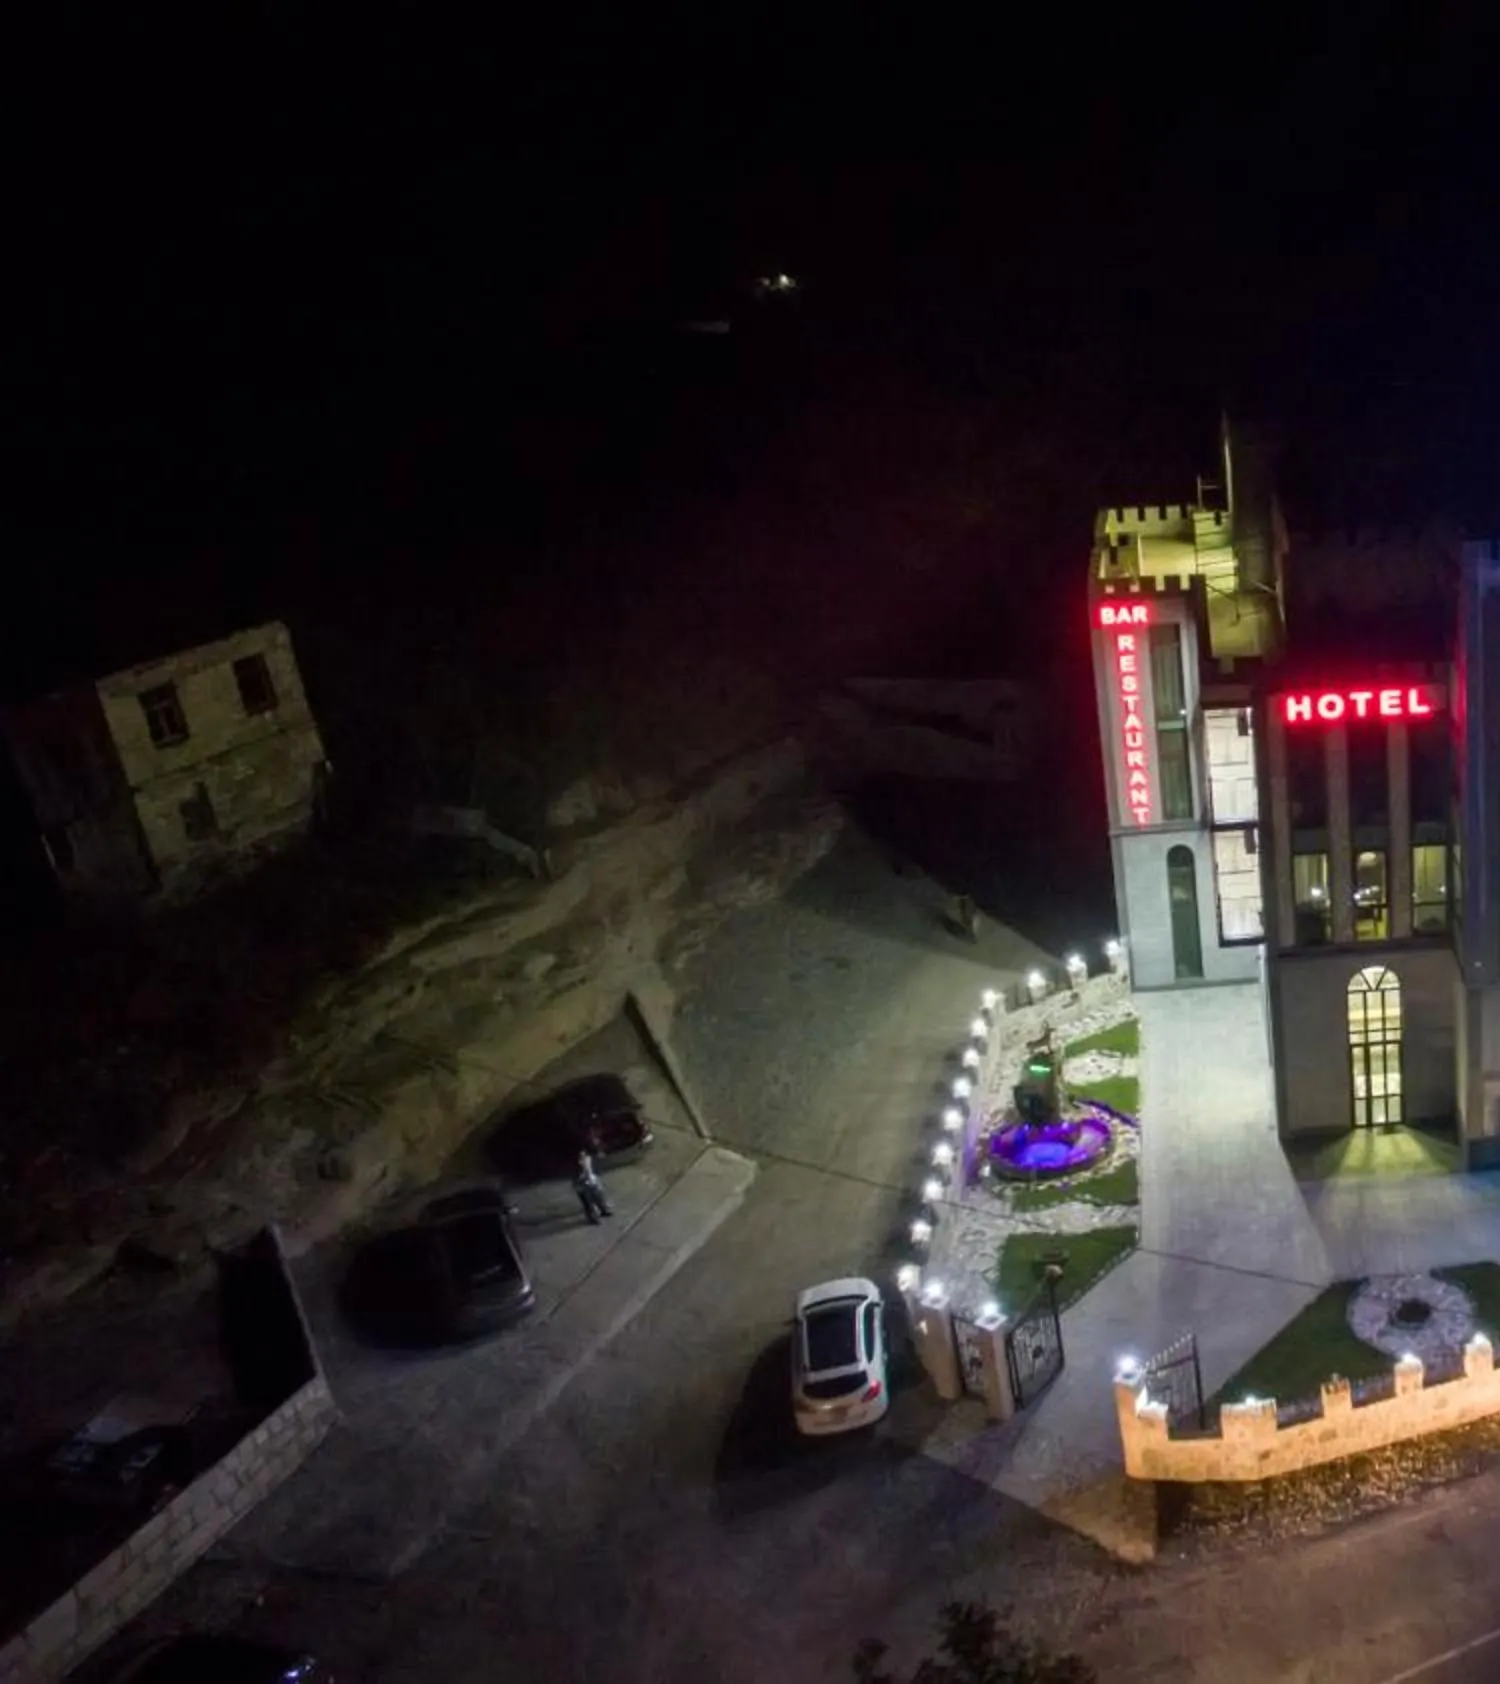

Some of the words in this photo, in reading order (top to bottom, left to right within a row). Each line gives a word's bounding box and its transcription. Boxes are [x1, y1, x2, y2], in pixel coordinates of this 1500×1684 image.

[1100, 605, 1148, 625] BAR
[1287, 688, 1429, 721] HOTEL
[1117, 634, 1150, 825] RESTAURANT
